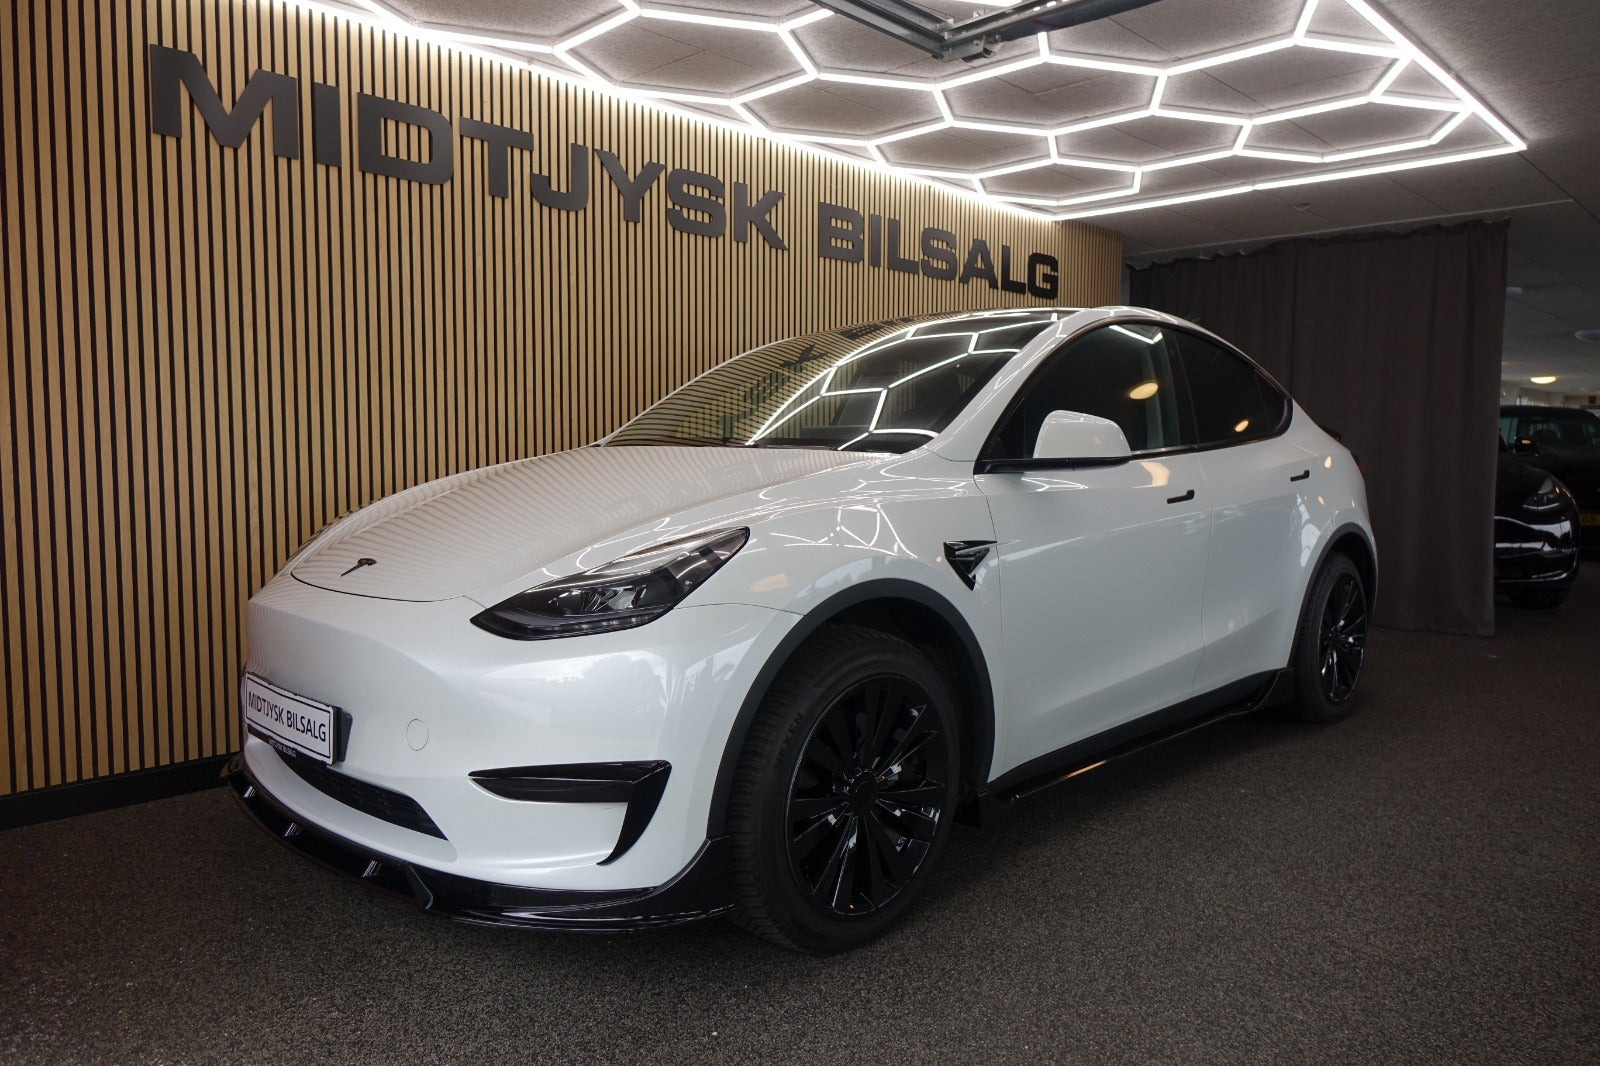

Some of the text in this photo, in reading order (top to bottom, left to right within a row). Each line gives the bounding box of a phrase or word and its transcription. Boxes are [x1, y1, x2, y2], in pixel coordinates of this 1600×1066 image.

[150, 44, 1059, 300] MIDTJYSK BILSALG
[248, 691, 326, 742] MIDTJYSK BILSALG
